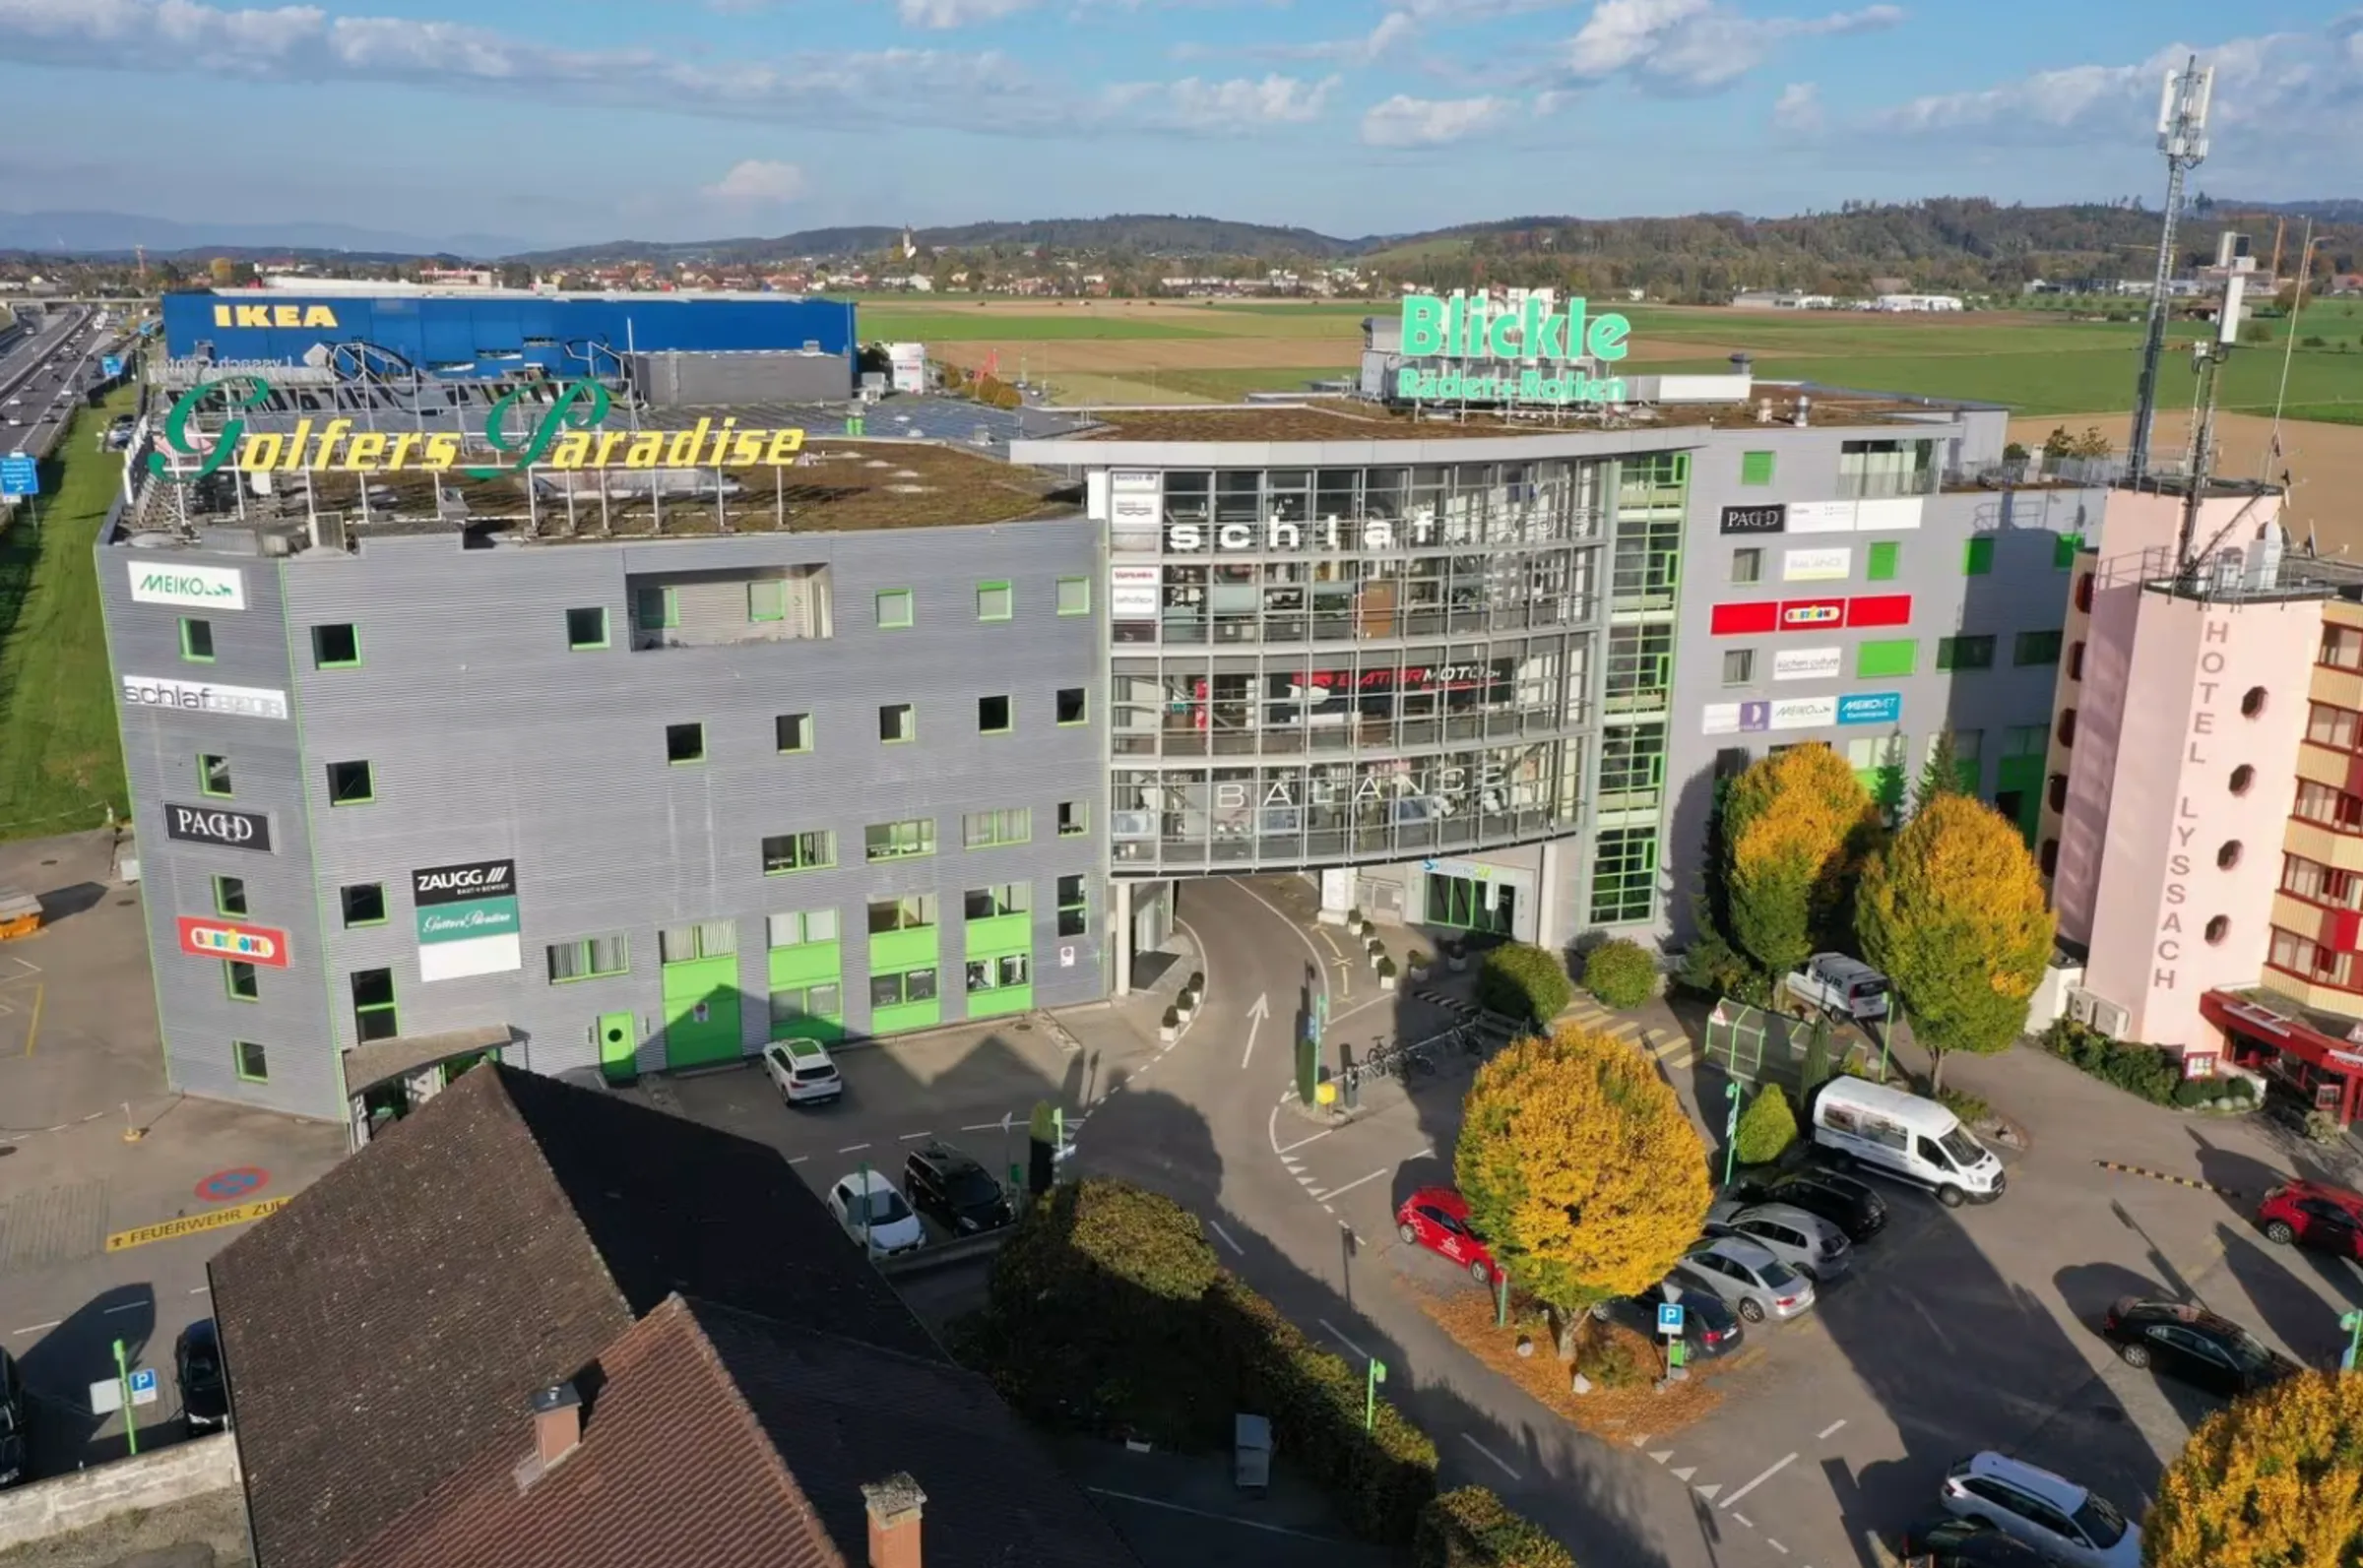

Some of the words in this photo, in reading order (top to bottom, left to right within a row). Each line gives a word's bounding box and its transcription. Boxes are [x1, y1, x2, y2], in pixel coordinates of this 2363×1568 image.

[214, 304, 339, 328] IKEA
[1401, 294, 1631, 362] Blickle
[148, 375, 463, 482] Golfers
[464, 377, 804, 481] Paradise
[140, 574, 204, 596] MEIKO
[2188, 621, 2229, 764] HOTEL
[1217, 763, 1506, 808] BALANCE
[417, 869, 482, 891] ZAUGG
[2153, 796, 2199, 989] LYSSACH
[129, 1209, 242, 1244] FEUERWEHR
